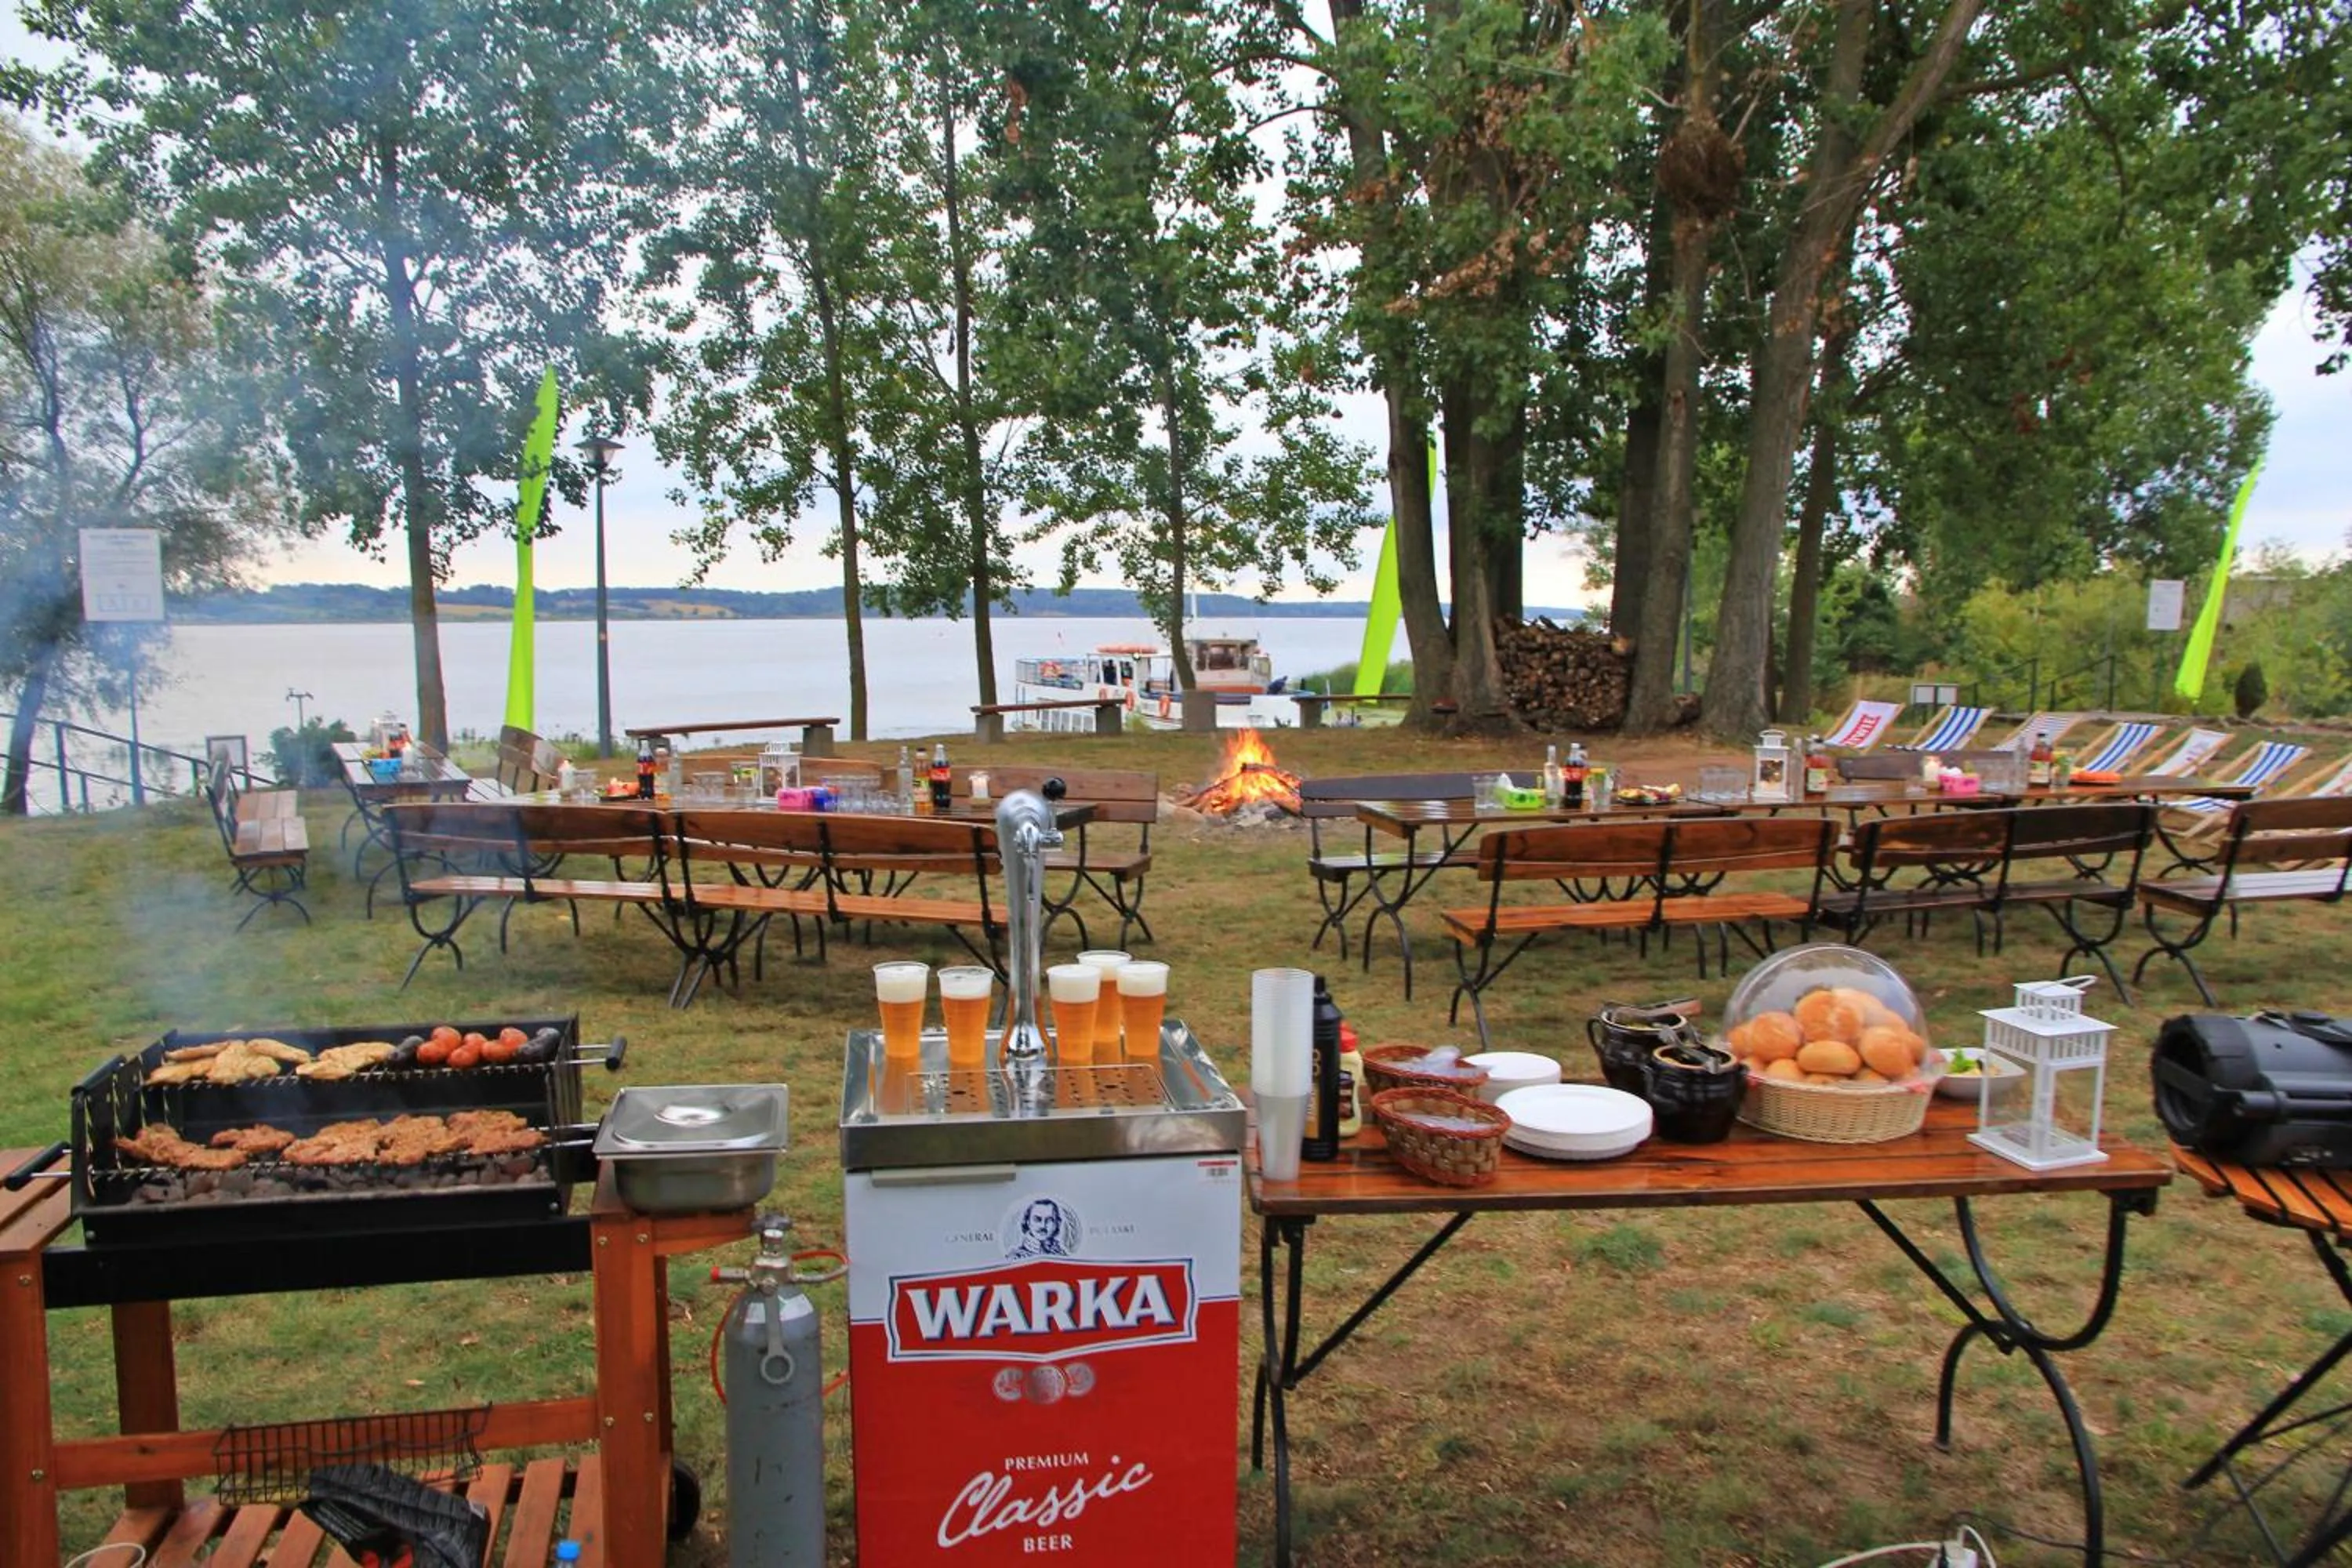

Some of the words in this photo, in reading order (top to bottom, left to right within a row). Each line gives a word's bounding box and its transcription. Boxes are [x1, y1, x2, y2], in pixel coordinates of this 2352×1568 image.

[944, 1231, 994, 1243] NERAL
[905, 1274, 1176, 1341] WARKA
[1004, 1451, 1090, 1472] PREMIUM
[937, 1454, 1154, 1548] Classic
[1022, 1534, 1073, 1553] BEER
